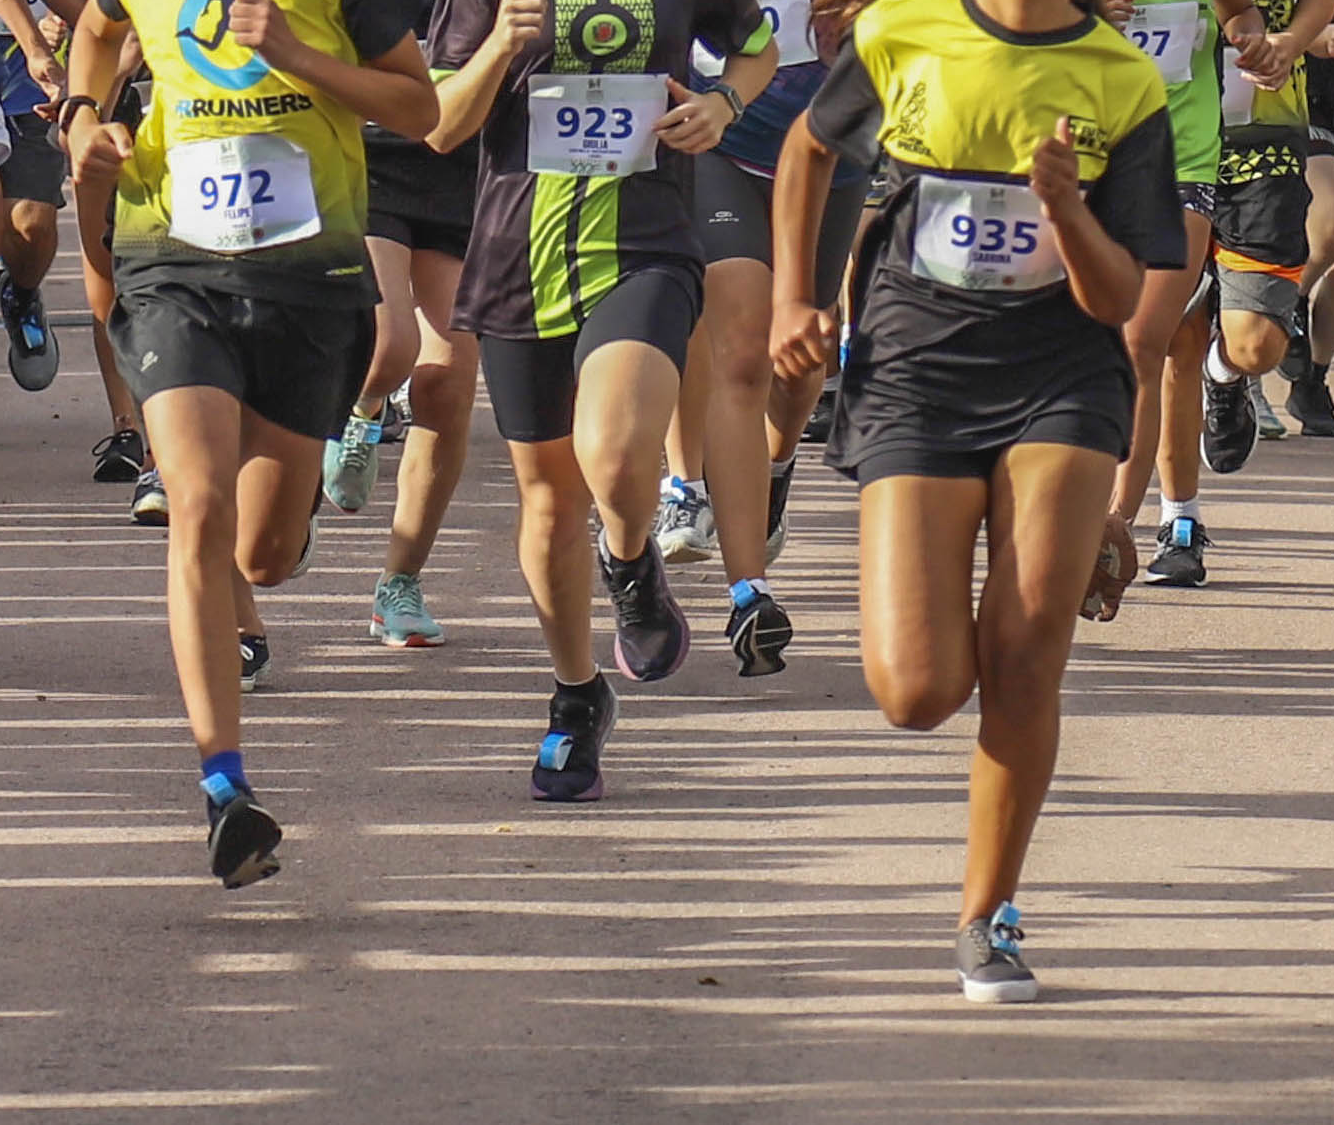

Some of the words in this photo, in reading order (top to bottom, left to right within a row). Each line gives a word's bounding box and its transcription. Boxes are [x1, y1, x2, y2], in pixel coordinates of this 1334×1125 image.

[1131, 29, 1171, 57] 27
[556, 106, 634, 140] 923
[200, 168, 276, 211] 972
[950, 214, 1040, 255] 935
